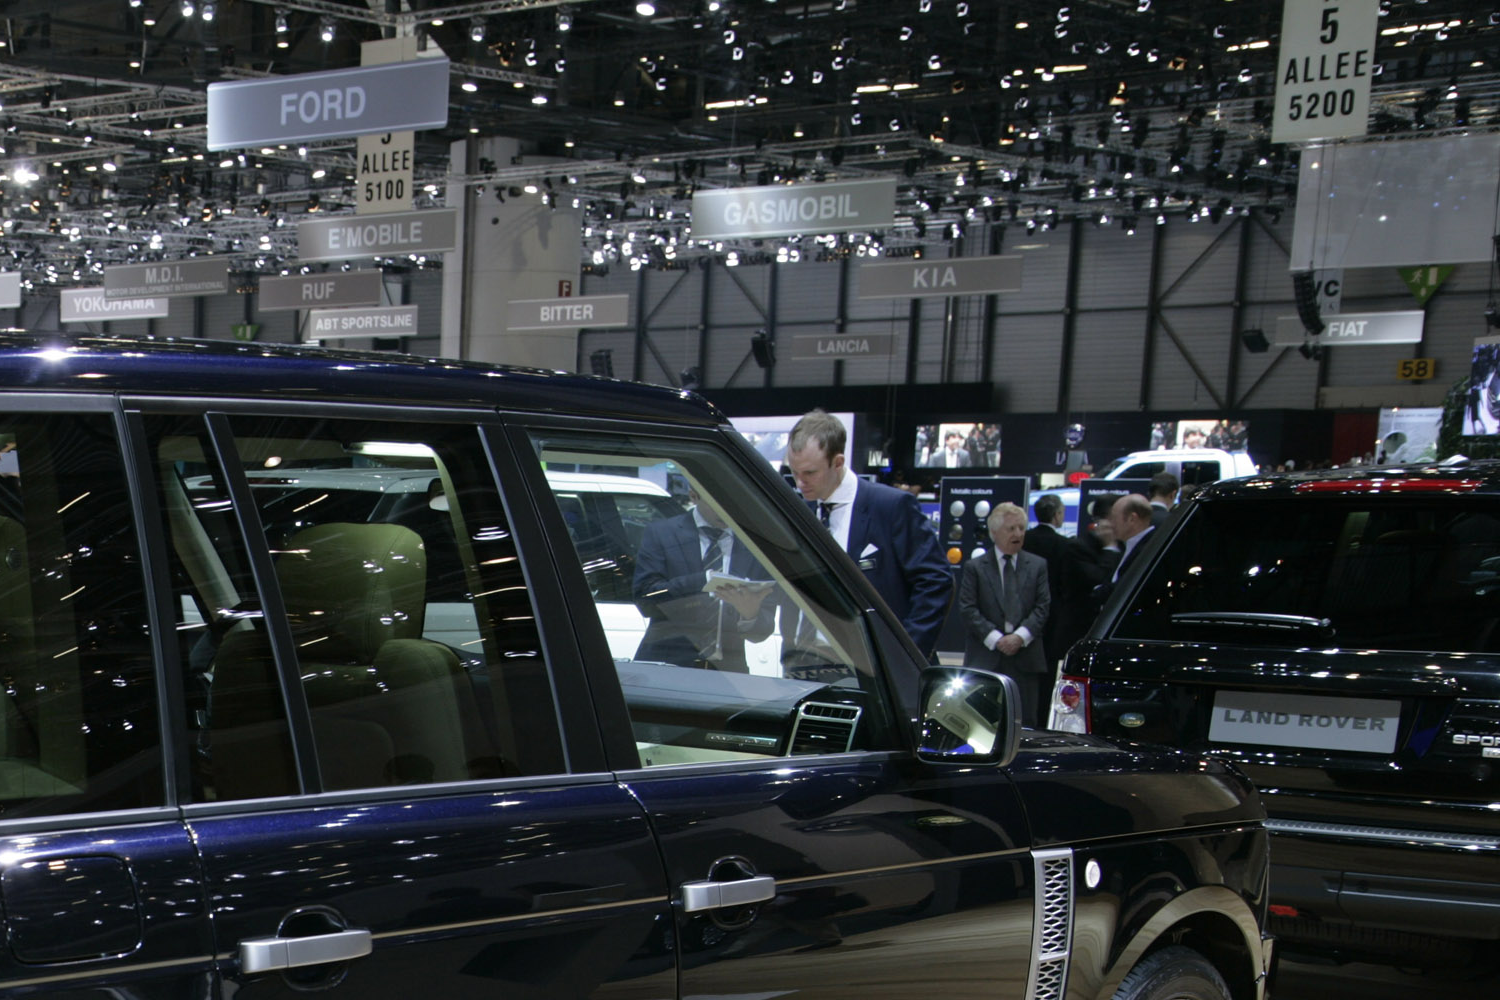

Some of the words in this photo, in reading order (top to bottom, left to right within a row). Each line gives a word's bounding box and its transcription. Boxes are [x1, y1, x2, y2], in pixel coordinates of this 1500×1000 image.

[1320, 7, 1339, 45] 5
[1284, 50, 1368, 85] ALLEE
[280, 87, 366, 126] FORD
[1289, 89, 1355, 121] 5200
[362, 150, 410, 174] ALLEE
[366, 179, 404, 201] 5100
[723, 194, 859, 226] GASMOBIL
[328, 222, 422, 249] E'MOBILE
[145, 266, 184, 284] M.D.I.
[913, 267, 957, 288] KIA
[302, 282, 335, 300] RUF
[562, 284, 571, 297] F
[73, 298, 155, 312] YOKOHAMA
[540, 305, 593, 322] BITTER
[316, 317, 339, 331] ABT
[341, 314, 413, 330] SPORTSLINE
[1328, 321, 1368, 337] FIAT
[817, 340, 870, 353] LANCIA
[1402, 361, 1428, 377] 58
[1224, 710, 1289, 726] LAND
[1298, 714, 1385, 731] ROVER
